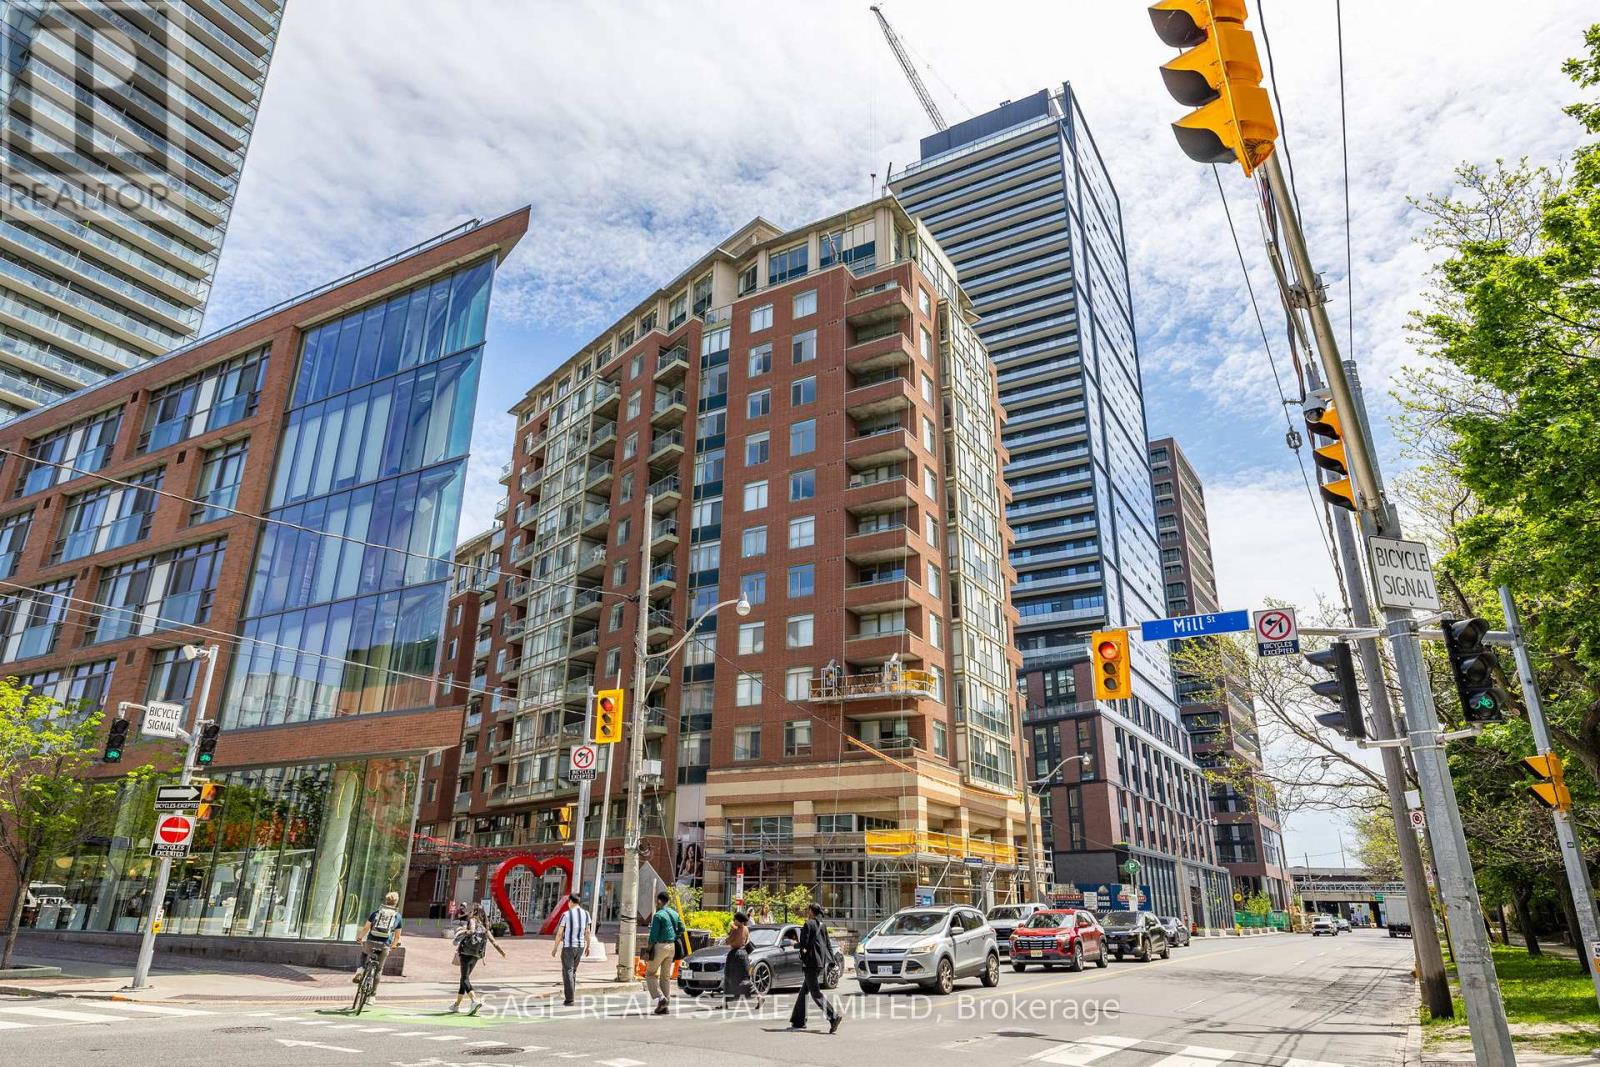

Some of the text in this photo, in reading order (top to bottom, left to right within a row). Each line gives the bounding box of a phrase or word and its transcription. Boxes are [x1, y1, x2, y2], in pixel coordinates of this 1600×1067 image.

[1375, 547, 1430, 572] BICYCLE
[1383, 575, 1434, 599] SIGNAL
[1173, 615, 1216, 633] Mill St
[1263, 648, 1295, 656] EXCEPTED
[1264, 641, 1293, 649] BICYCLES
[149, 706, 180, 720] BICYCLE
[147, 719, 175, 733] SIGNAL
